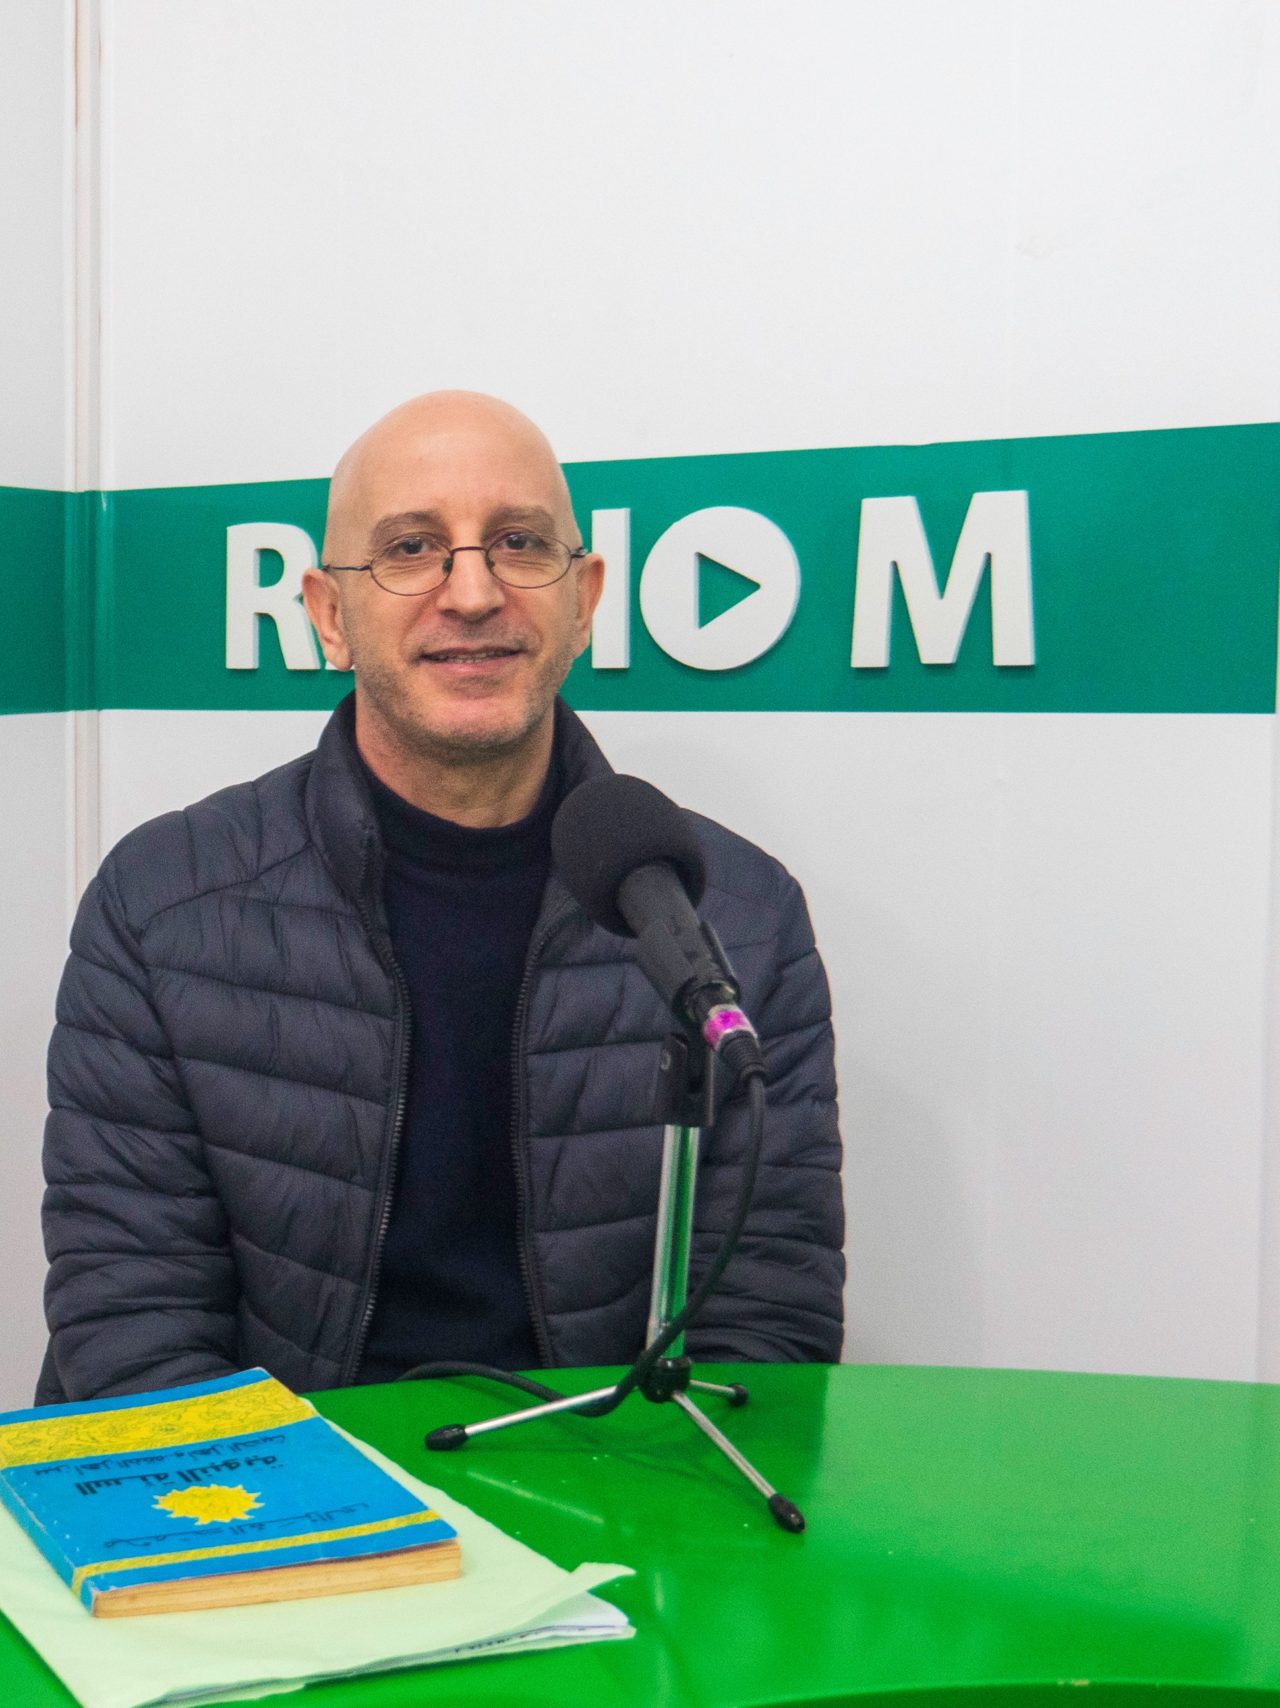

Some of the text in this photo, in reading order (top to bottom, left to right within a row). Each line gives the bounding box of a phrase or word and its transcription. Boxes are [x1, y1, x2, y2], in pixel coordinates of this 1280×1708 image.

[226, 489, 1037, 671] RIO M
[74, 1455, 285, 1497] السنة النبوية
